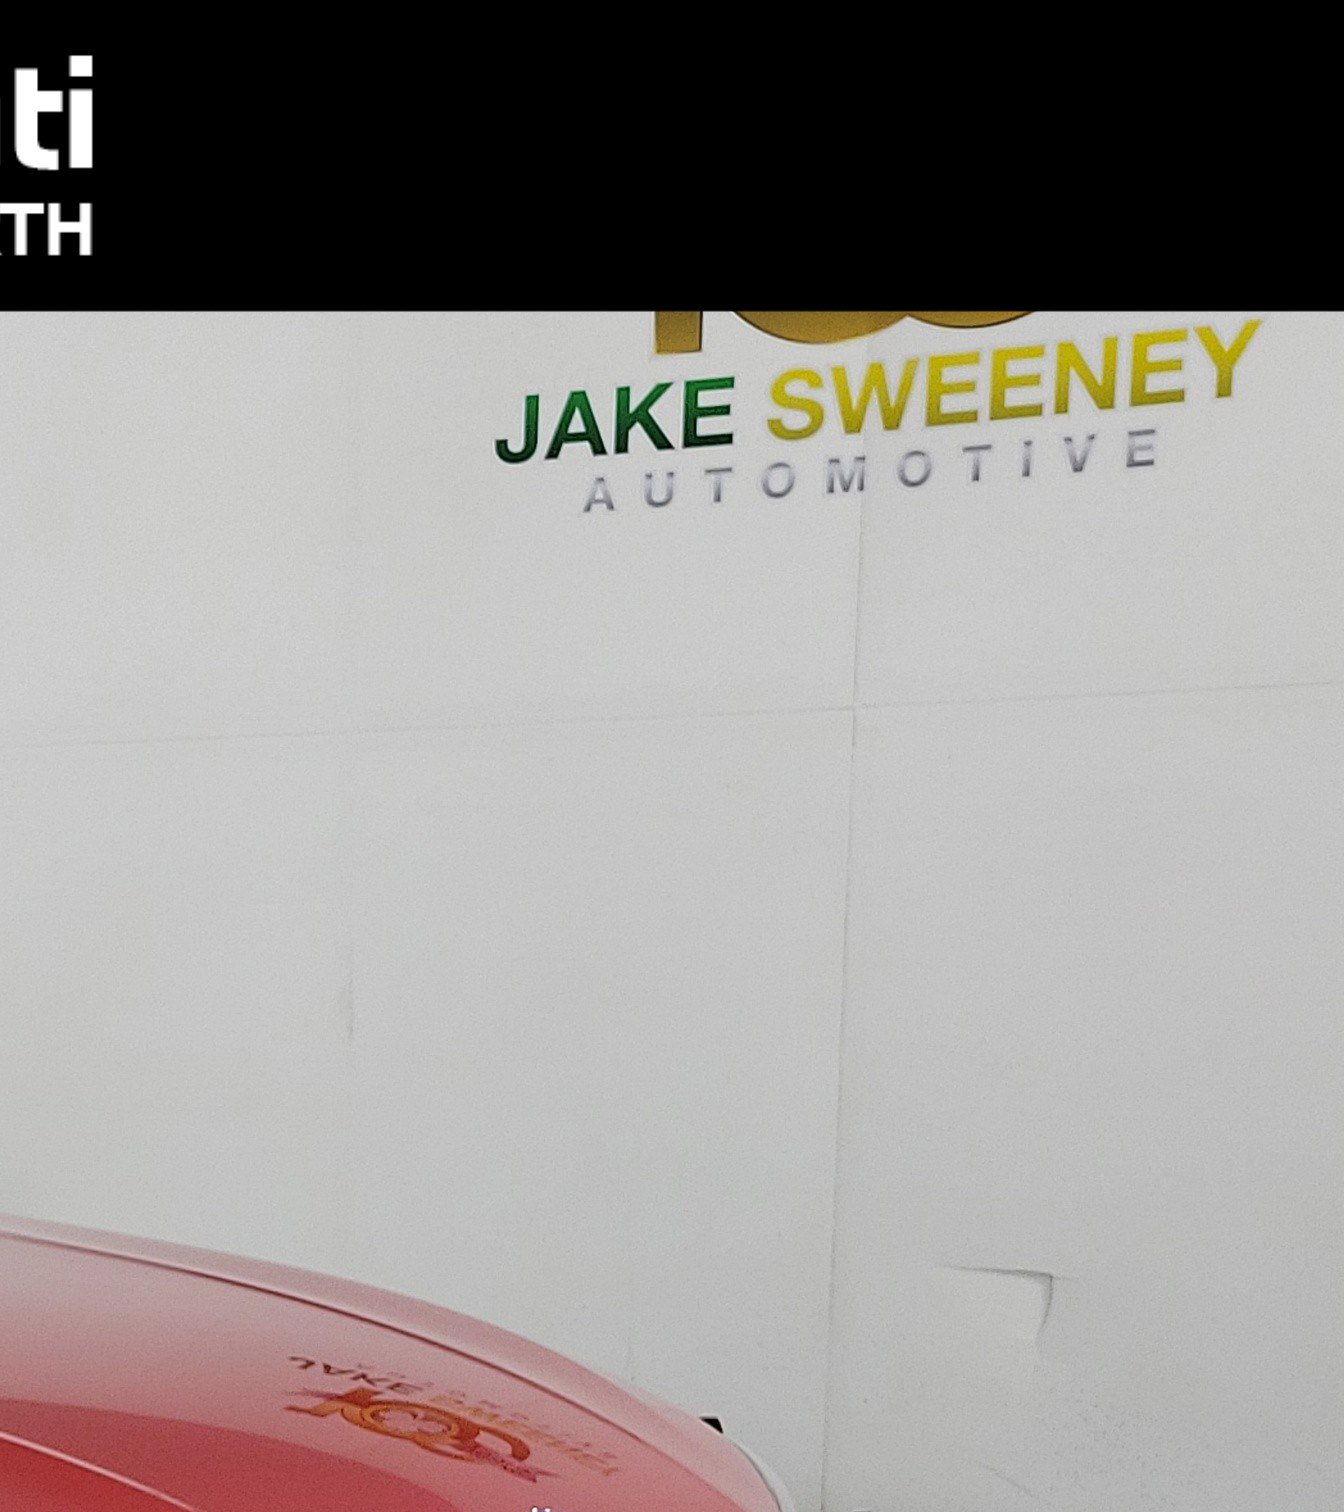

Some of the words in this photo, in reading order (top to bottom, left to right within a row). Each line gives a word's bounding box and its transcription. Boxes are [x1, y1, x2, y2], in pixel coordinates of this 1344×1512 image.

[494, 375, 737, 464] JAKE
[766, 318, 1263, 442] SWEENEY
[582, 428, 1158, 514] AUTOMOTIVE
